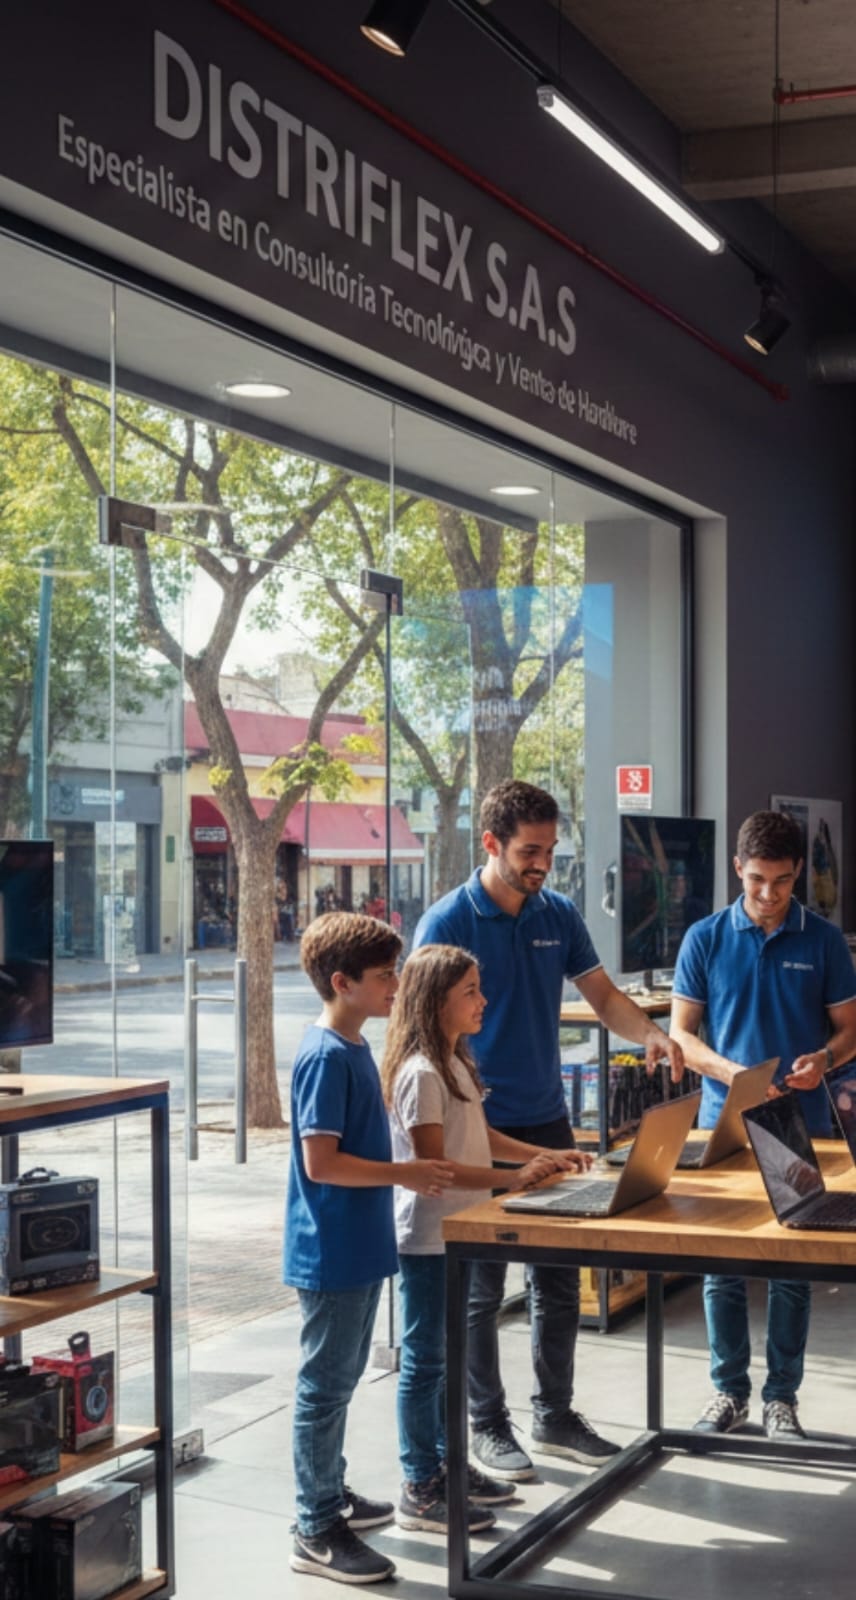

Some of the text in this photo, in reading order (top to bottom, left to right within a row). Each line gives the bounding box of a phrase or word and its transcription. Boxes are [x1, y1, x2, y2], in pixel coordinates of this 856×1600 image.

[58, 113, 211, 233] Especialista
[217, 209, 248, 250] en
[495, 351, 506, 385] y
[557, 380, 576, 414] de
[153, 29, 577, 356] DISTRIFLEX S.A.S
